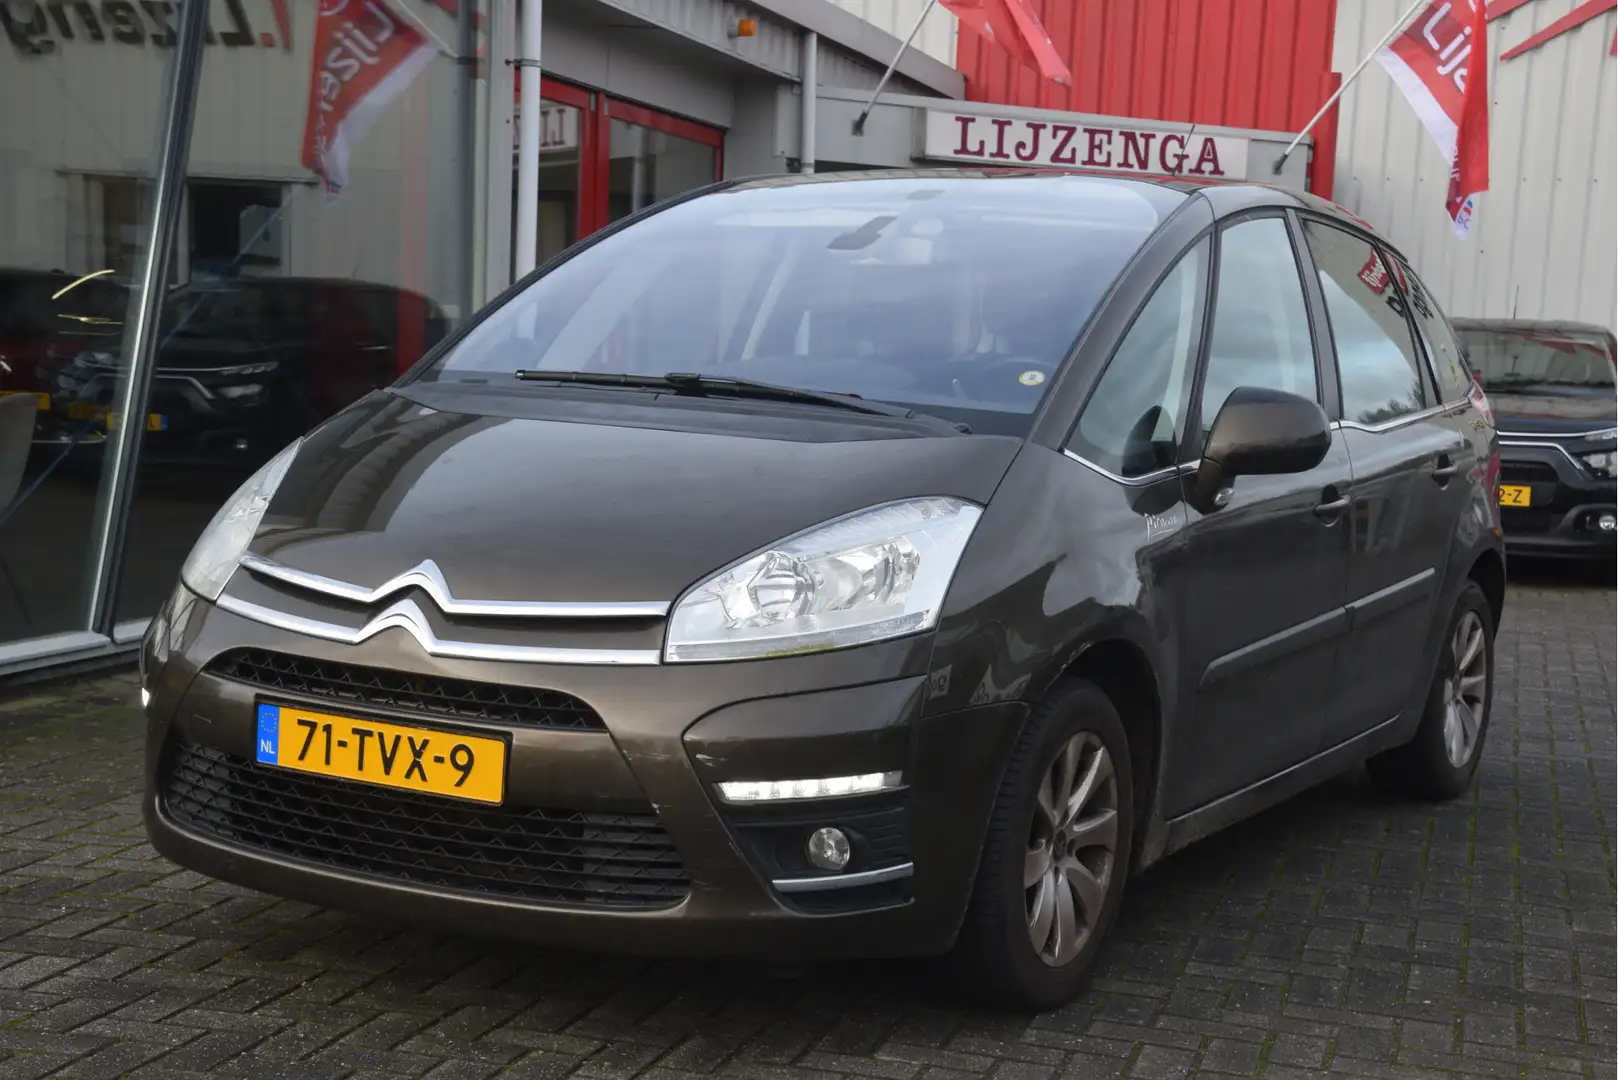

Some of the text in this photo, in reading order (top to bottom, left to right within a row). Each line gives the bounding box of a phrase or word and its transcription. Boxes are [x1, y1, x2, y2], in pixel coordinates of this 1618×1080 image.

[953, 116, 1225, 176] LIJZENGA
[260, 719, 475, 787] NL 71-TVX-9
